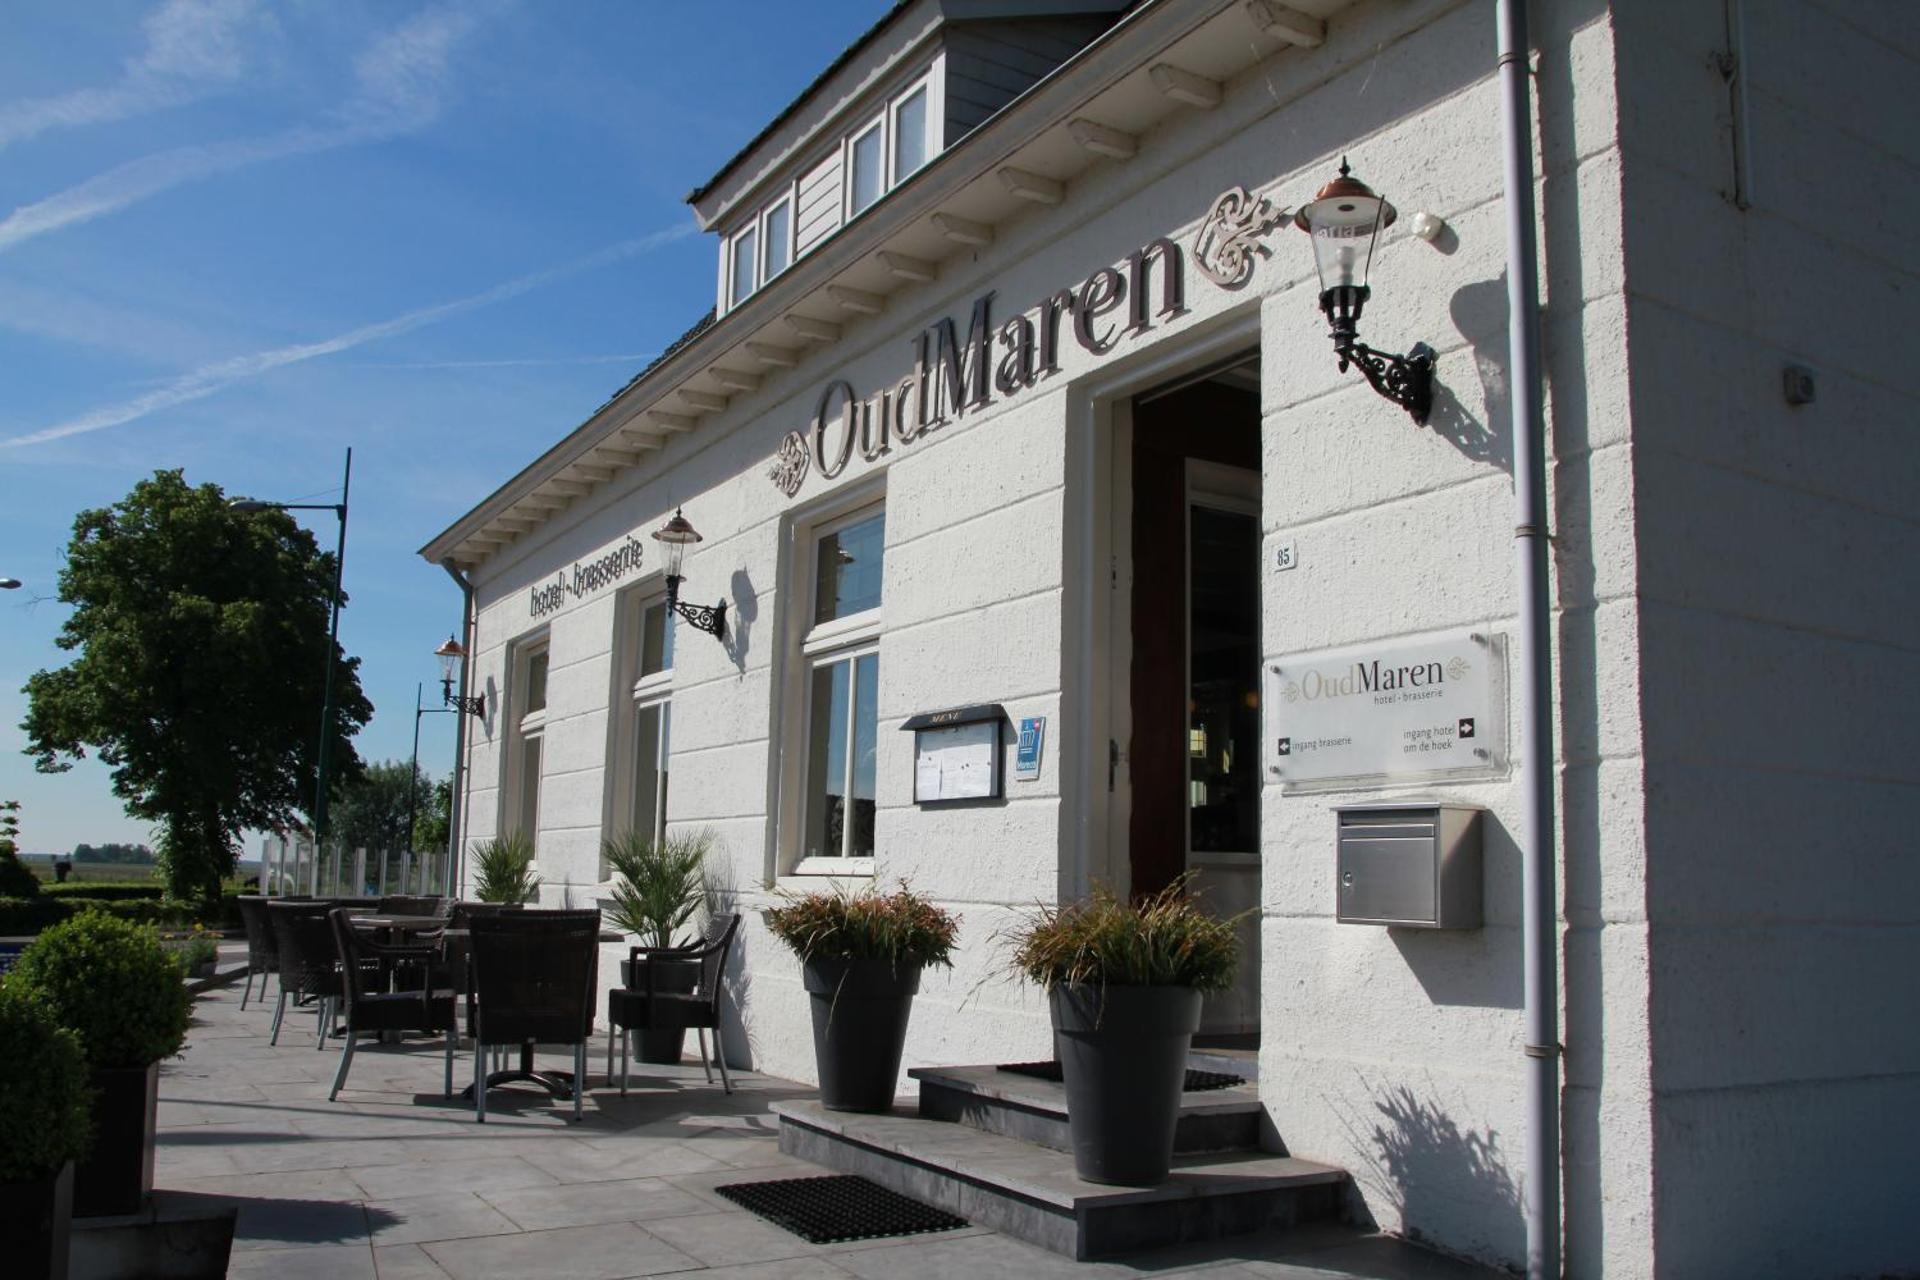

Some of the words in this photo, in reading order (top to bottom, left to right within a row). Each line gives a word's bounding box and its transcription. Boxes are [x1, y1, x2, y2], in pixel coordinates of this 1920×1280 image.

[1277, 547, 1290, 567] 85
[530, 571, 566, 618] hotel
[573, 534, 643, 599] brasserie
[1374, 694, 1396, 705] hotel
[1403, 687, 1443, 702] brasserie
[1404, 728, 1432, 740] ingang
[1433, 724, 1455, 737] hotel
[1404, 744, 1417, 753] om
[1419, 741, 1431, 751] de
[1432, 739, 1453, 751] hoek
